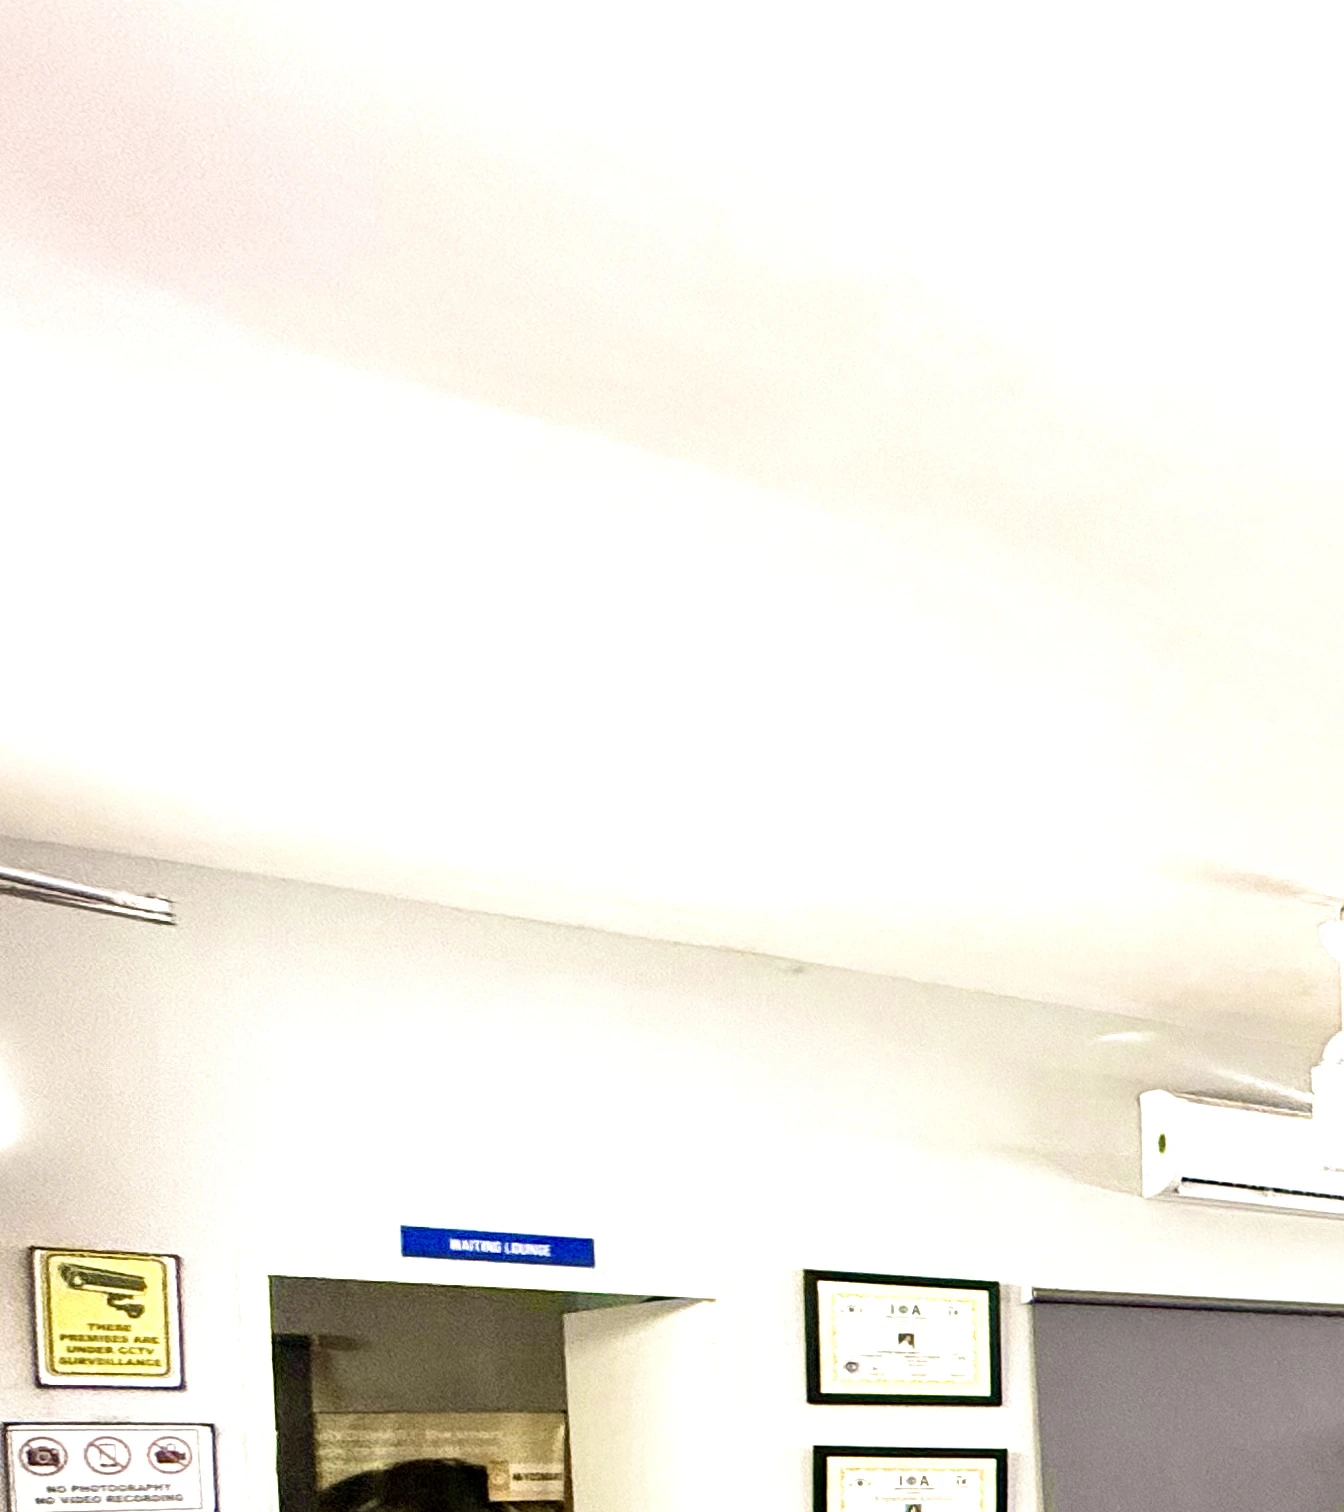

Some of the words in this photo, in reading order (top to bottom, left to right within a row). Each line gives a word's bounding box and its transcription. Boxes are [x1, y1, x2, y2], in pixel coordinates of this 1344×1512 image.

[87, 1323, 132, 1332] THESE
[60, 1334, 129, 1343] PREMISES
[133, 1336, 160, 1344] ARE
[66, 1346, 113, 1354] UNDER
[118, 1347, 154, 1355] CCTV
[59, 1357, 162, 1367] SURVEILLANCE
[71, 1484, 171, 1492] PHOTOGRAPHY
[59, 1496, 102, 1504] VIDEO
[106, 1494, 184, 1503] RECORDING
